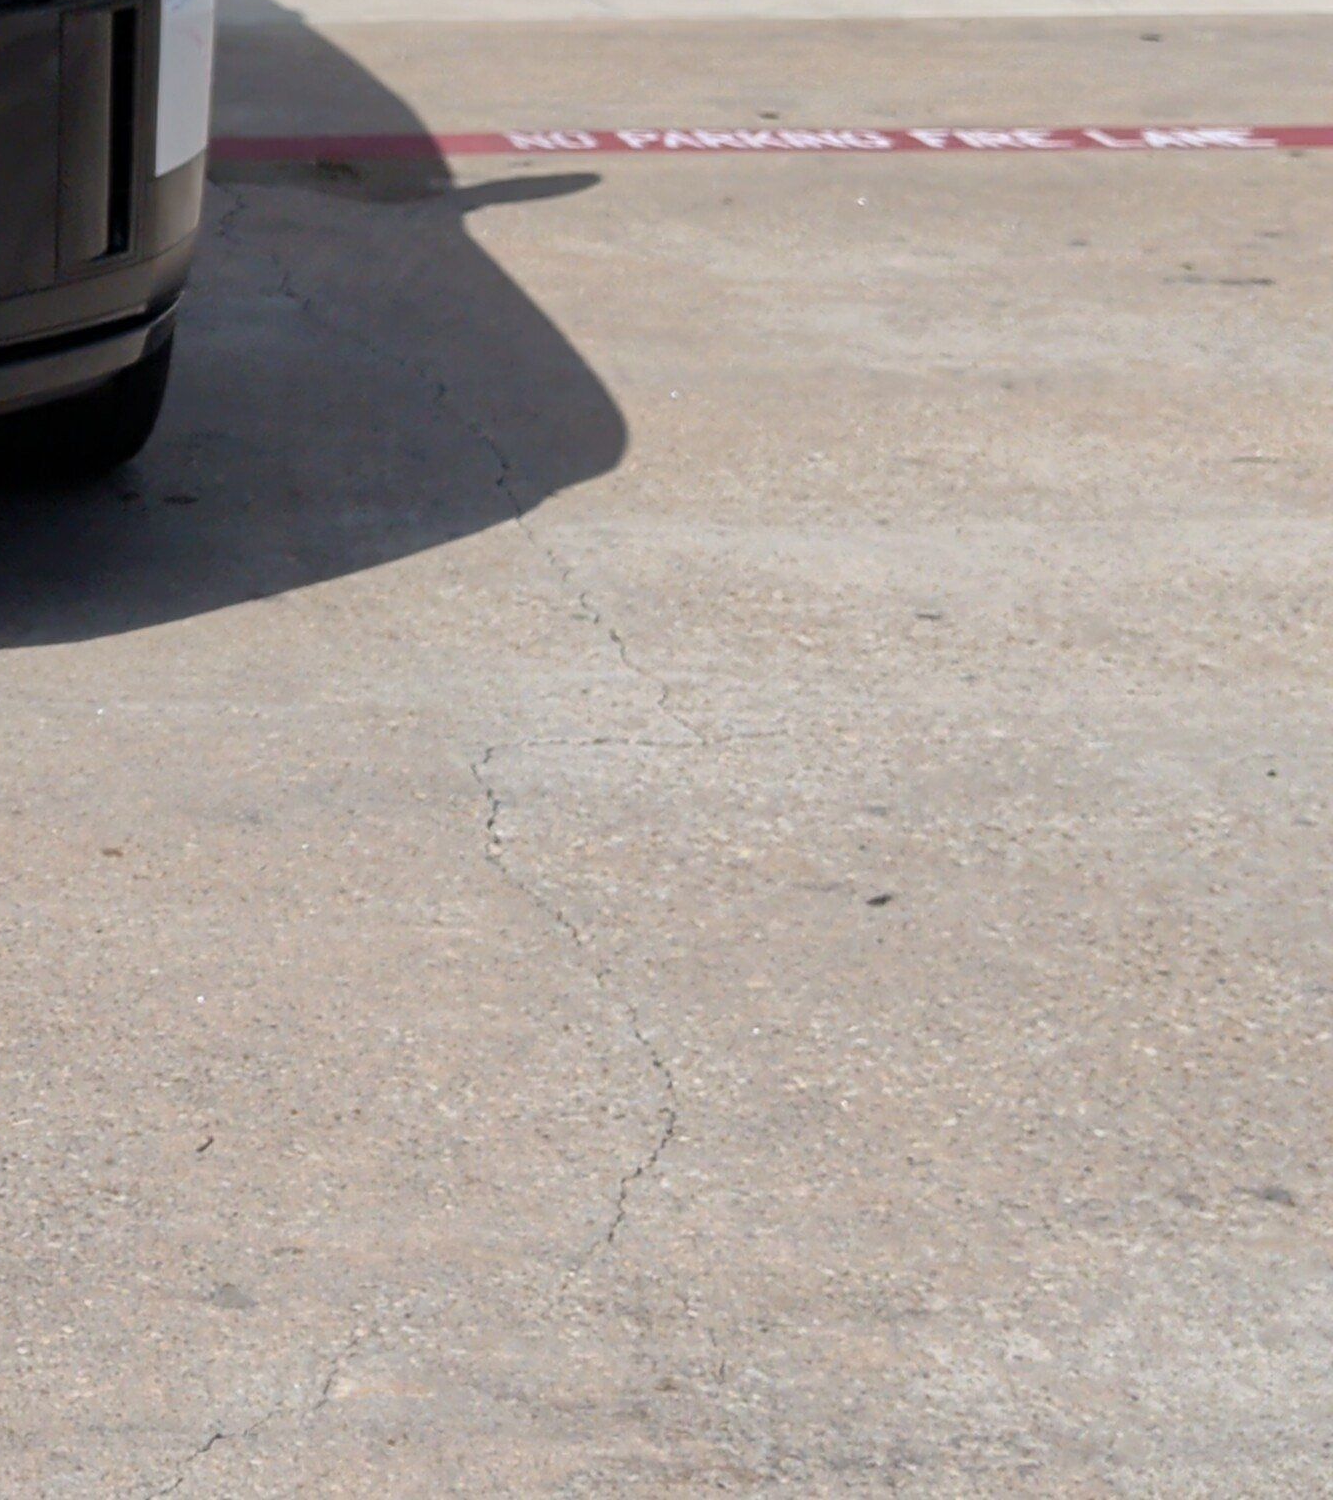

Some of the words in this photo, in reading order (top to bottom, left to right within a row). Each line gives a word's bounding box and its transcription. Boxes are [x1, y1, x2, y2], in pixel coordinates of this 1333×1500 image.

[506, 130, 598, 150] NO
[615, 129, 893, 150] PARKING
[908, 128, 1075, 148] FIRE
[1082, 128, 1278, 149] LANE
